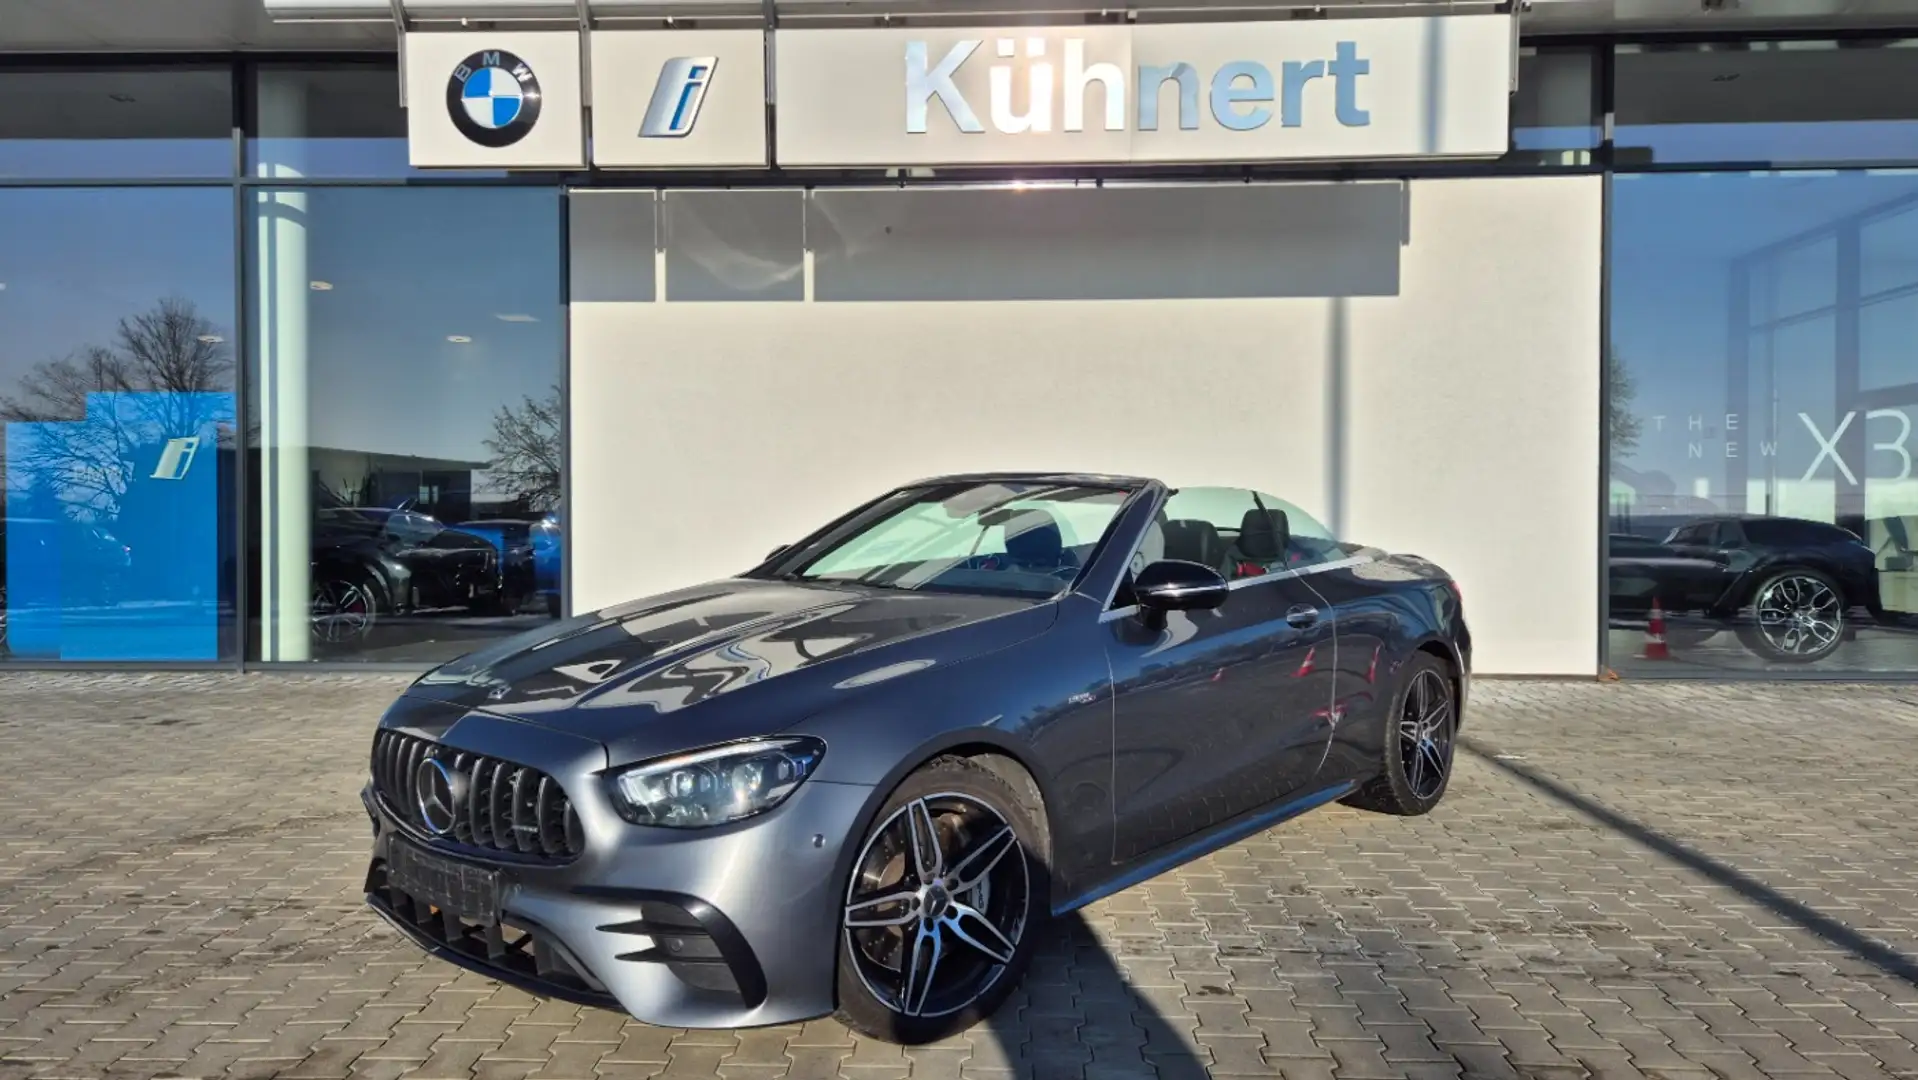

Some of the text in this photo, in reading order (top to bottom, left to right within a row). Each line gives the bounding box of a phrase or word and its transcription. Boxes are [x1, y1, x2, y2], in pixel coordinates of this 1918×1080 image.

[454, 51, 532, 82] BMW
[905, 37, 1371, 134] Kühnert
[1652, 413, 1739, 430] THE
[1688, 440, 1778, 458] NEW
[1798, 409, 1912, 485] X3
